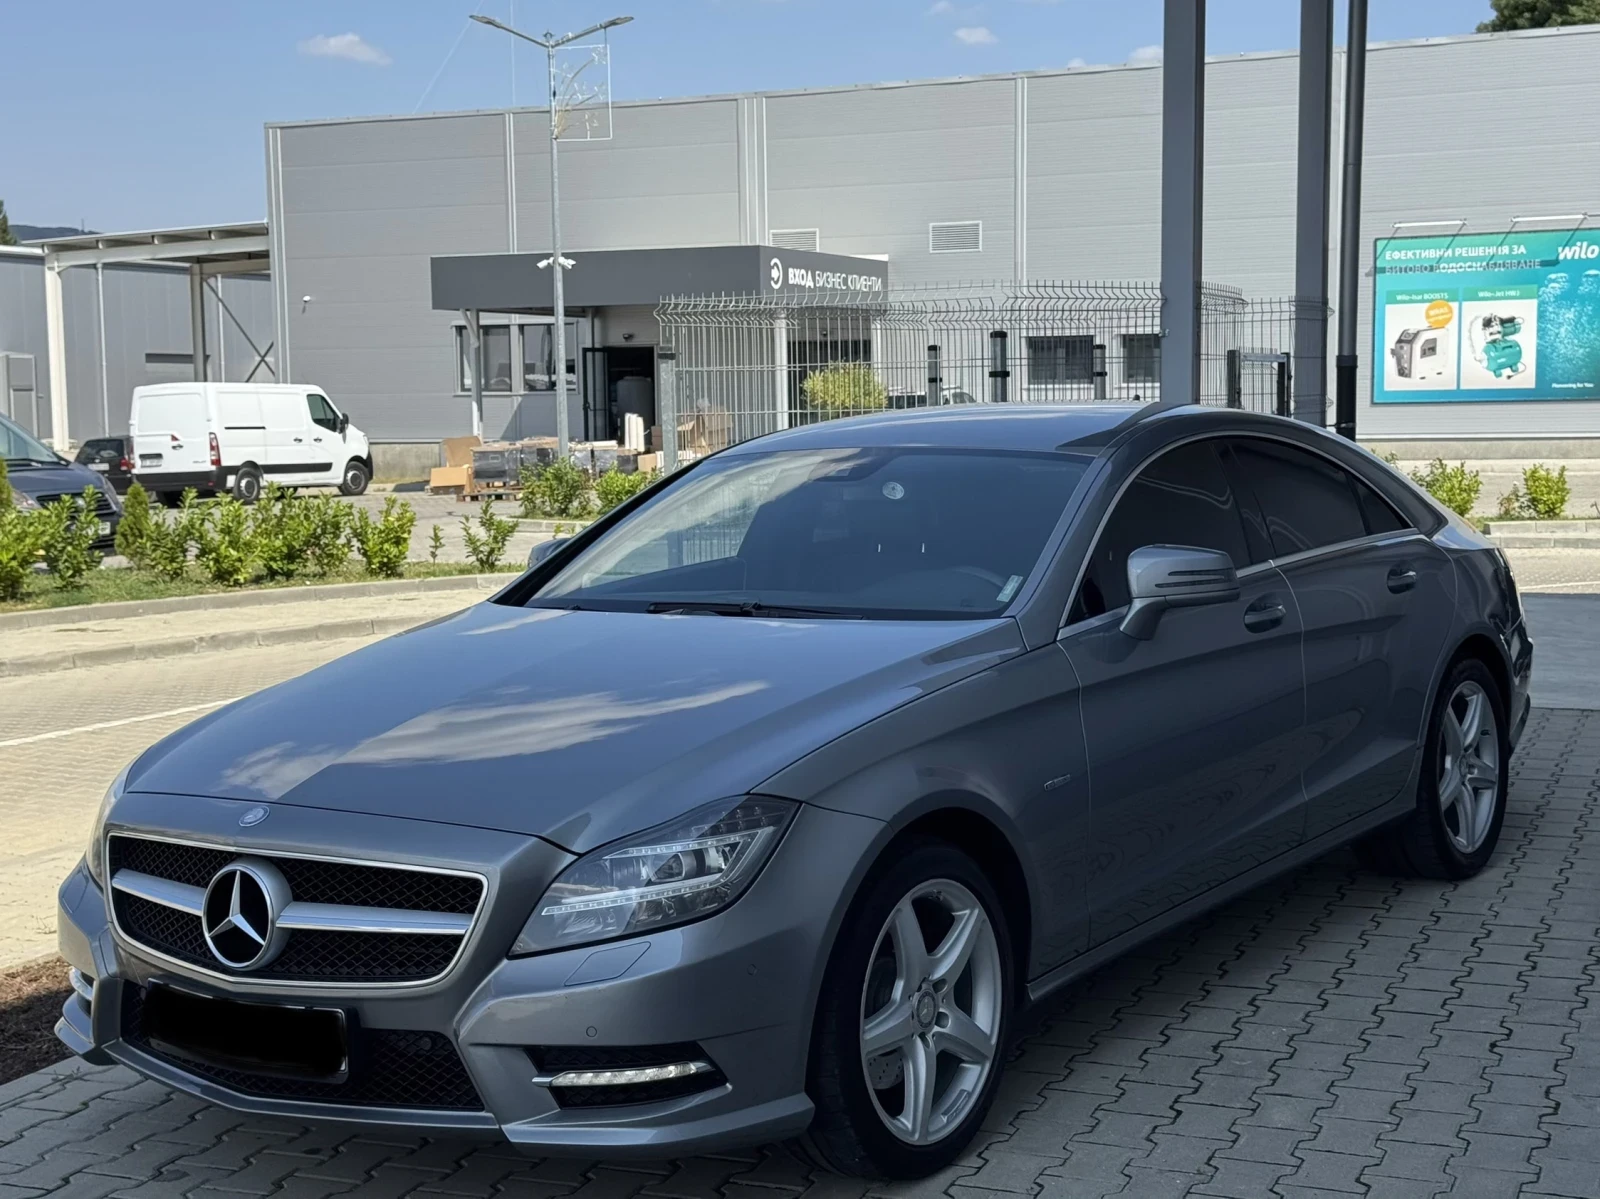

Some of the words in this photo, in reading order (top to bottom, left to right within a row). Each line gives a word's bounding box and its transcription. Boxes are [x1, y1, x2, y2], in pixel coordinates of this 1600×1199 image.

[1385, 248, 1452, 261] ЕФЕКТИВНИ
[1455, 246, 1509, 258] РЕШЕНИЯ
[1511, 245, 1527, 255] ЗА
[1558, 241, 1600, 260] wilo
[1385, 263, 1430, 275] БИТОВО
[1433, 259, 1541, 274] ВОДОСНАБДЯВАНЕ
[788, 267, 814, 289] ВХОД
[815, 271, 847, 290] БИЗНЕС
[848, 274, 882, 292] КЛИЕНТИ
